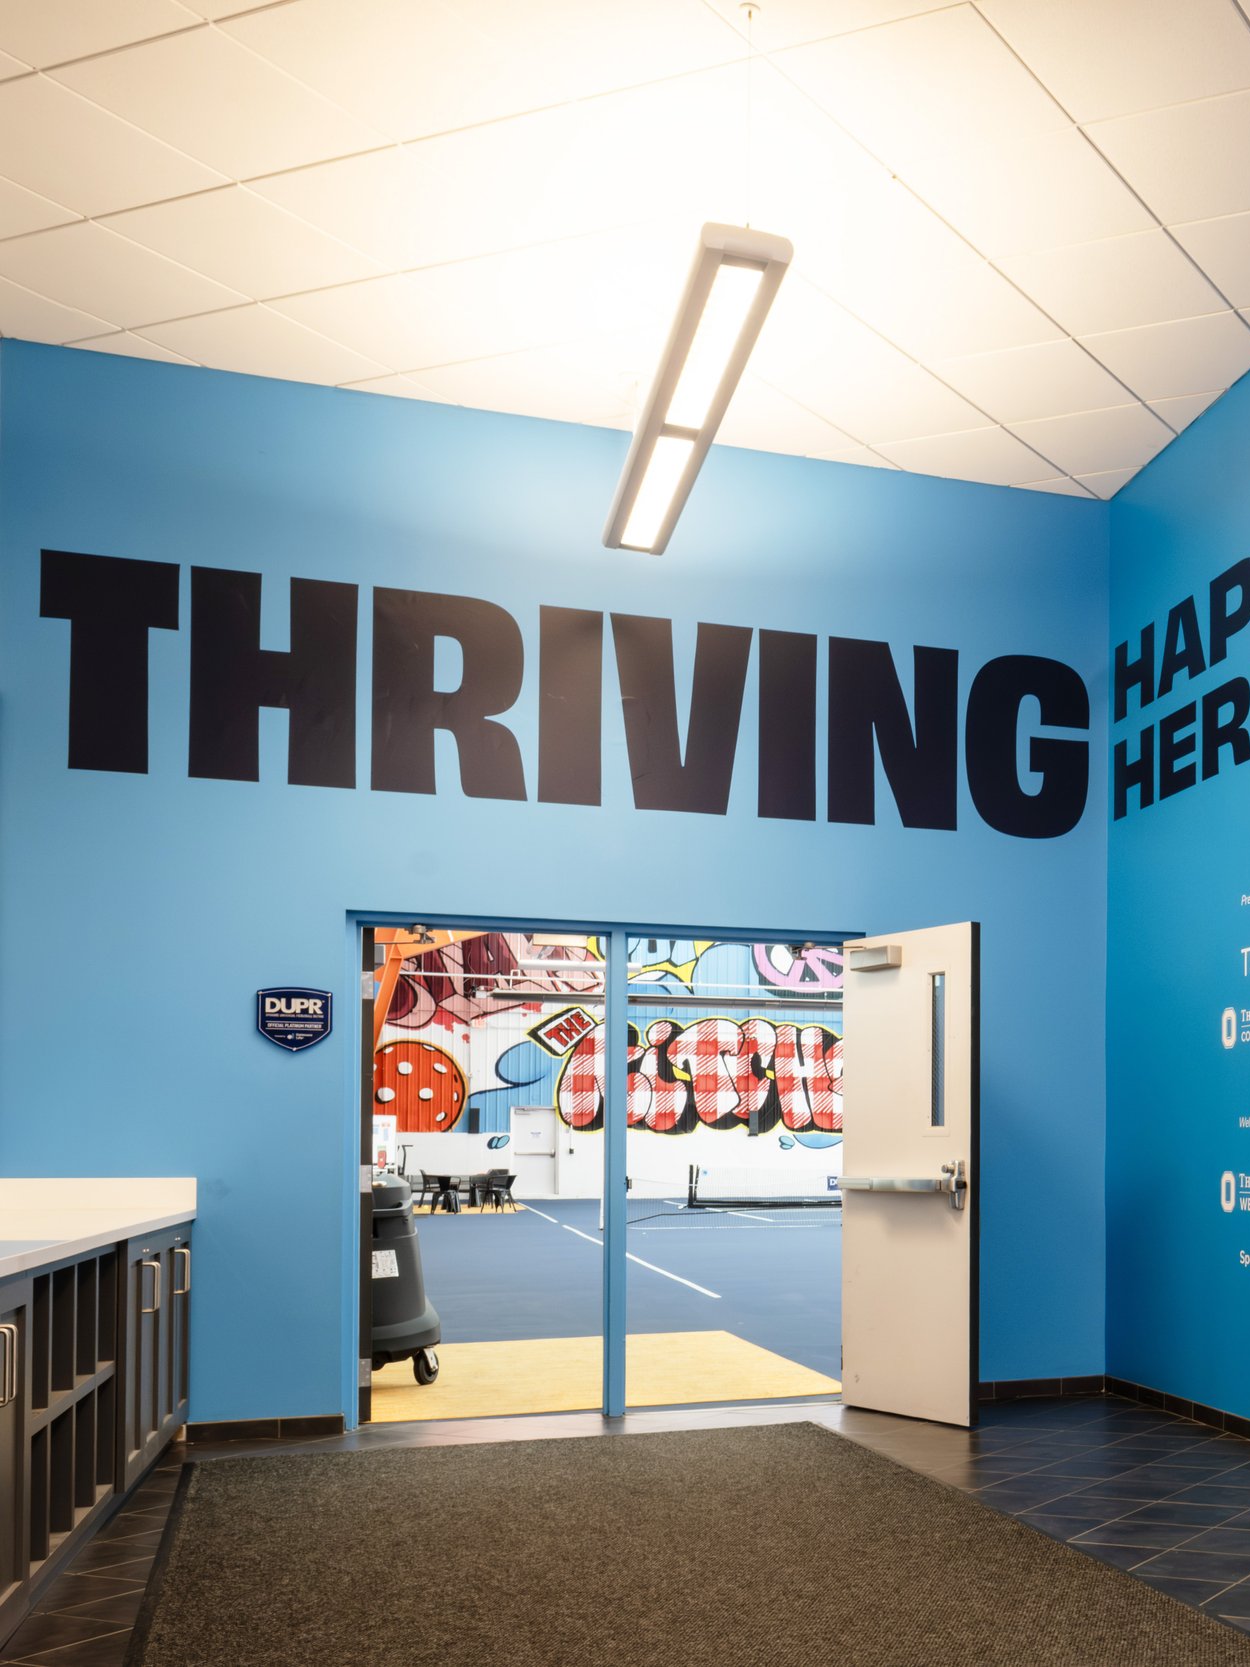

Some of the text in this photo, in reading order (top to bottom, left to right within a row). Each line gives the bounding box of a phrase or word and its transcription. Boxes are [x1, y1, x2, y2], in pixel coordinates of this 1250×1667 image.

[39, 548, 1090, 839] THRIVING
[265, 997, 324, 1014] DUPR
[543, 1010, 591, 1048] THE
